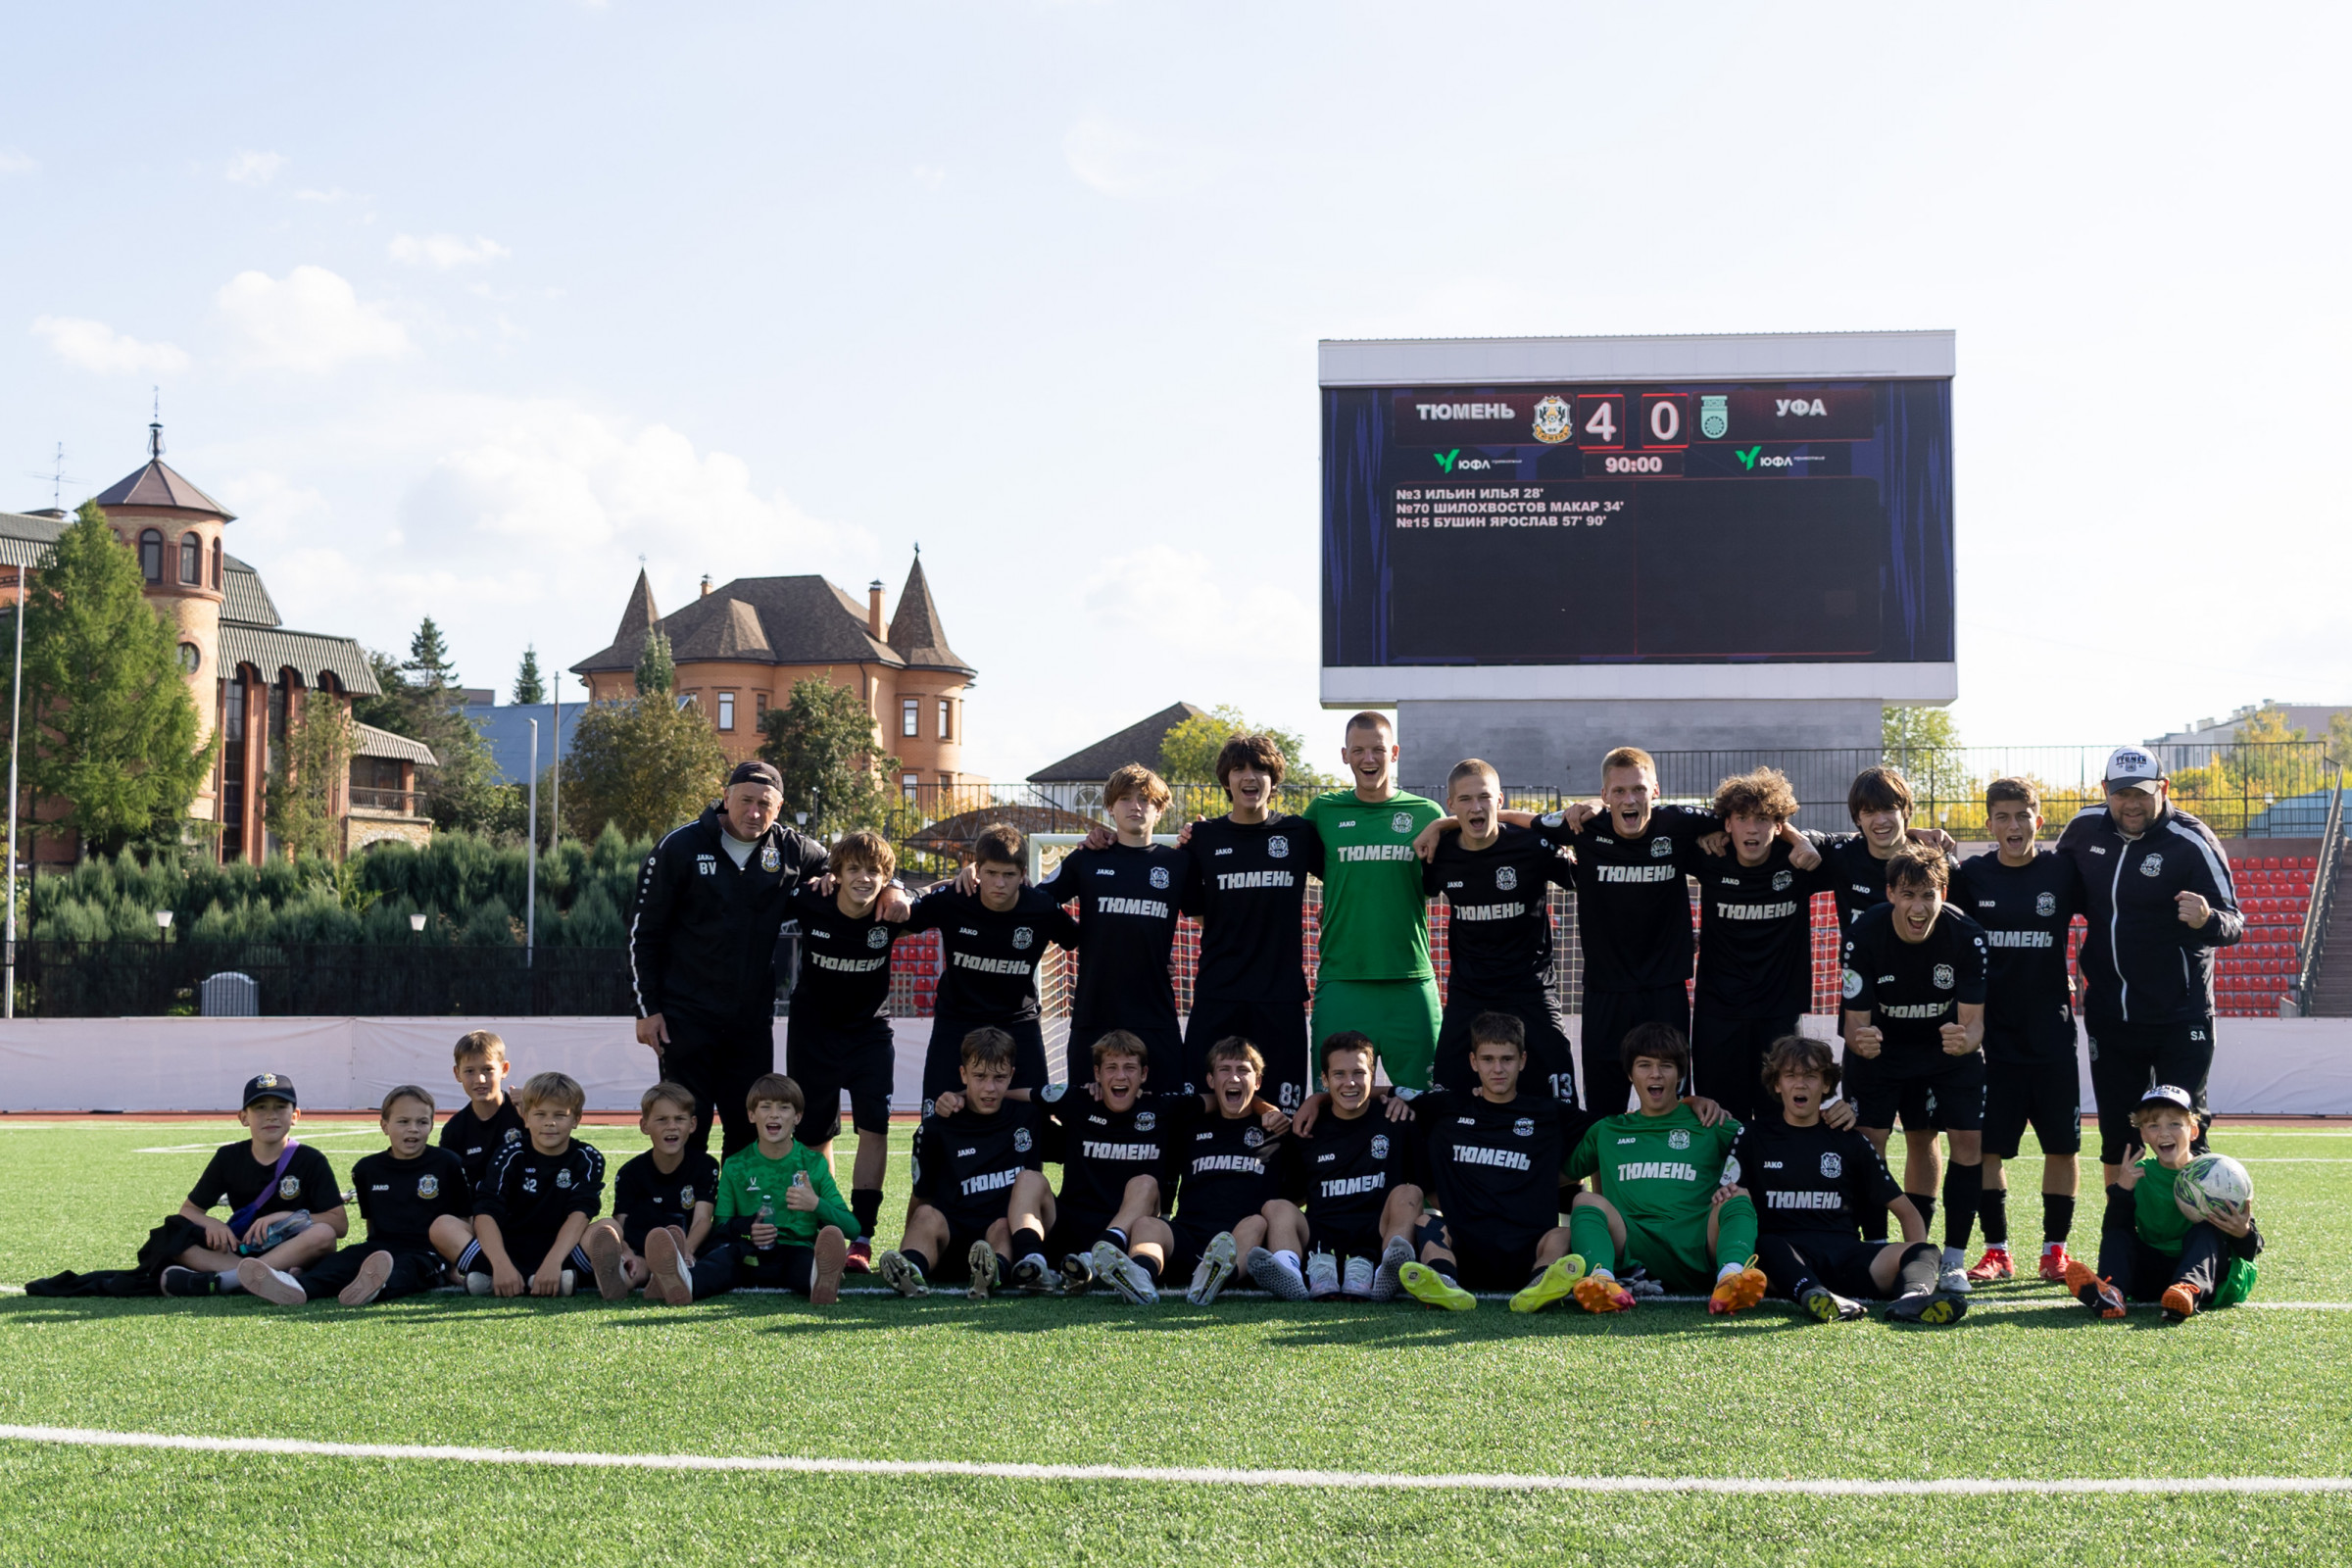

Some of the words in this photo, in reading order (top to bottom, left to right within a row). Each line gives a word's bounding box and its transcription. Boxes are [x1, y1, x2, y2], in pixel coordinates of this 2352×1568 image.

[1416, 403, 1516, 420] ТЮМЕНЬ
[1776, 399, 1828, 416] УФА
[1585, 402, 1617, 441] 4
[1650, 401, 1680, 440] 0
[1458, 459, 1491, 470] ЮФЛ
[1605, 457, 1663, 473] 90:00
[1760, 455, 1793, 466] ЮФЛ
[1396, 489, 1421, 500] №3
[1425, 489, 1476, 500] ИЛЬИН
[1480, 488, 1520, 499] ИЛЬЯ
[1396, 503, 1430, 514] №70
[1434, 502, 1546, 514] ШИЛОХВОСТОВ
[1550, 501, 1599, 513] МАКАР
[1396, 517, 1430, 528] №15
[1434, 516, 1486, 528] БУШИН
[1490, 515, 1558, 527] ЯРОСЛАВ
[1595, 835, 1614, 845] JAKO
[1215, 847, 1233, 856] JAKO
[1338, 845, 1416, 862] ТЮМЕНЬ
[698, 861, 717, 875] BV
[1596, 864, 1676, 882] ТЮМЕНЬ
[1217, 870, 1294, 890] ТЮМЕНЬ
[1721, 876, 1740, 886] JAKO
[1097, 897, 1168, 918] ТЮМЕНЬ
[1453, 902, 1525, 921] ТЮМЕНЬ
[1717, 900, 1797, 920] ТЮМЕНЬ
[811, 928, 831, 939] JAKO
[958, 927, 978, 936] JAKO
[1984, 930, 2053, 948] ЮМЕНЬ
[954, 952, 1031, 975] ТЮМЕНЬ
[1878, 997, 1955, 1018] ТЮМЕН
[2189, 1031, 2206, 1042] SA
[1548, 1072, 1573, 1099] 13
[1278, 1081, 1301, 1109] 83
[1088, 1114, 1107, 1126] JAKO
[1456, 1116, 1475, 1126] JAKO
[957, 1148, 976, 1157] JAKO
[1082, 1140, 1160, 1160] ТЮМЕНЬ
[1317, 1152, 1336, 1163] JAKO
[1452, 1145, 1531, 1170] ТЮМЕНЬ
[1192, 1154, 1265, 1175] ТЮМЕНЬ
[1617, 1162, 1697, 1182] ТЮМЕНЬ
[960, 1165, 1026, 1197] ТЮМЕ
[1320, 1171, 1386, 1198] ТЮМЕНЬ
[1765, 1191, 1842, 1209] ТЮМЕНЬ
